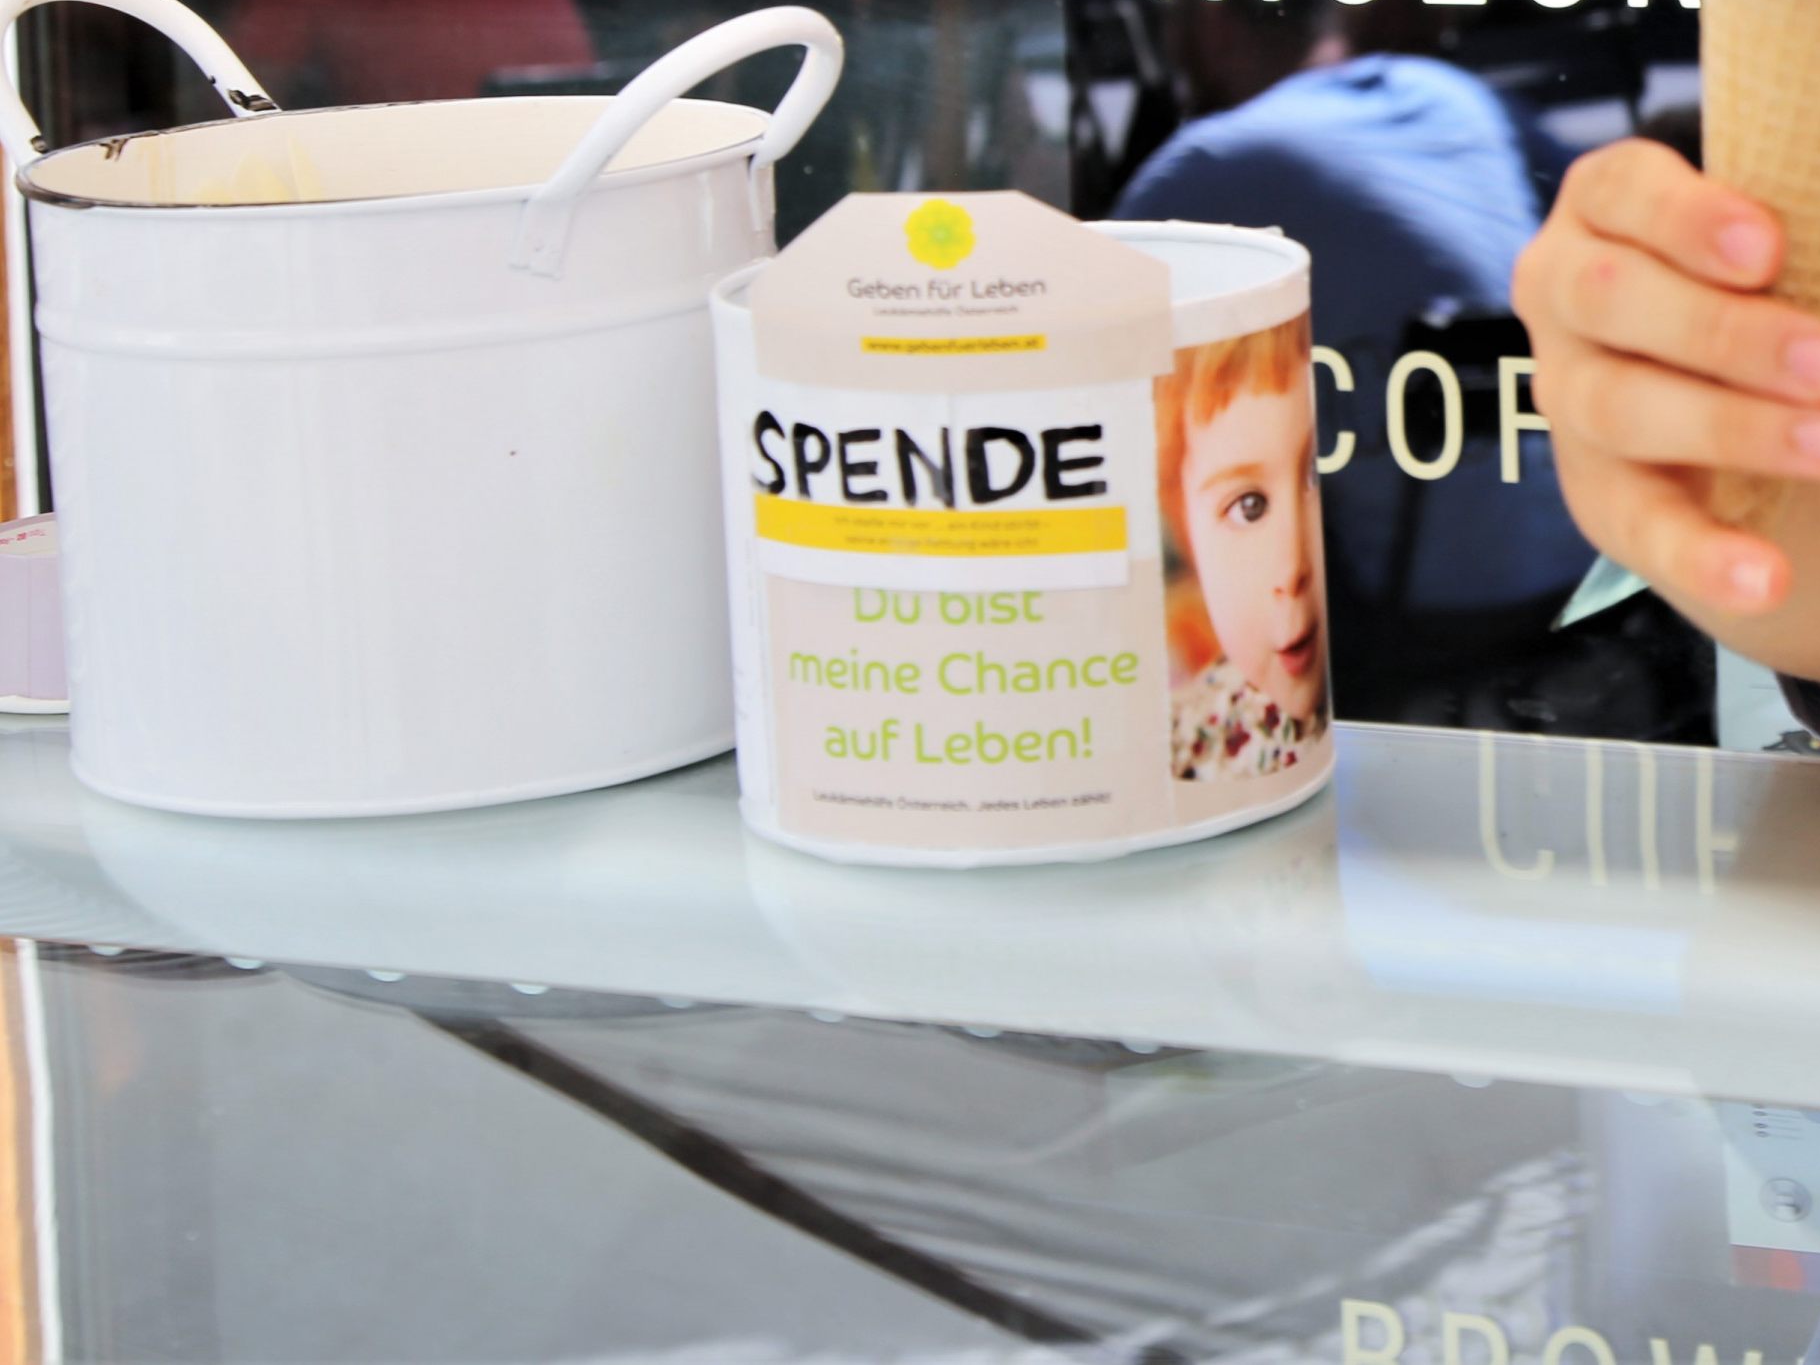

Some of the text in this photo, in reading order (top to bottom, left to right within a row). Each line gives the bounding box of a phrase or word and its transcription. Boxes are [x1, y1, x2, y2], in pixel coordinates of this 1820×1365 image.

[847, 277, 1047, 300] Geben für Leben
[1310, 345, 1554, 484] COF
[752, 410, 1108, 510] SPENDE
[853, 588, 1044, 625] Du bist
[789, 648, 1140, 695] meine Chance
[824, 717, 1093, 766] auf Leben!
